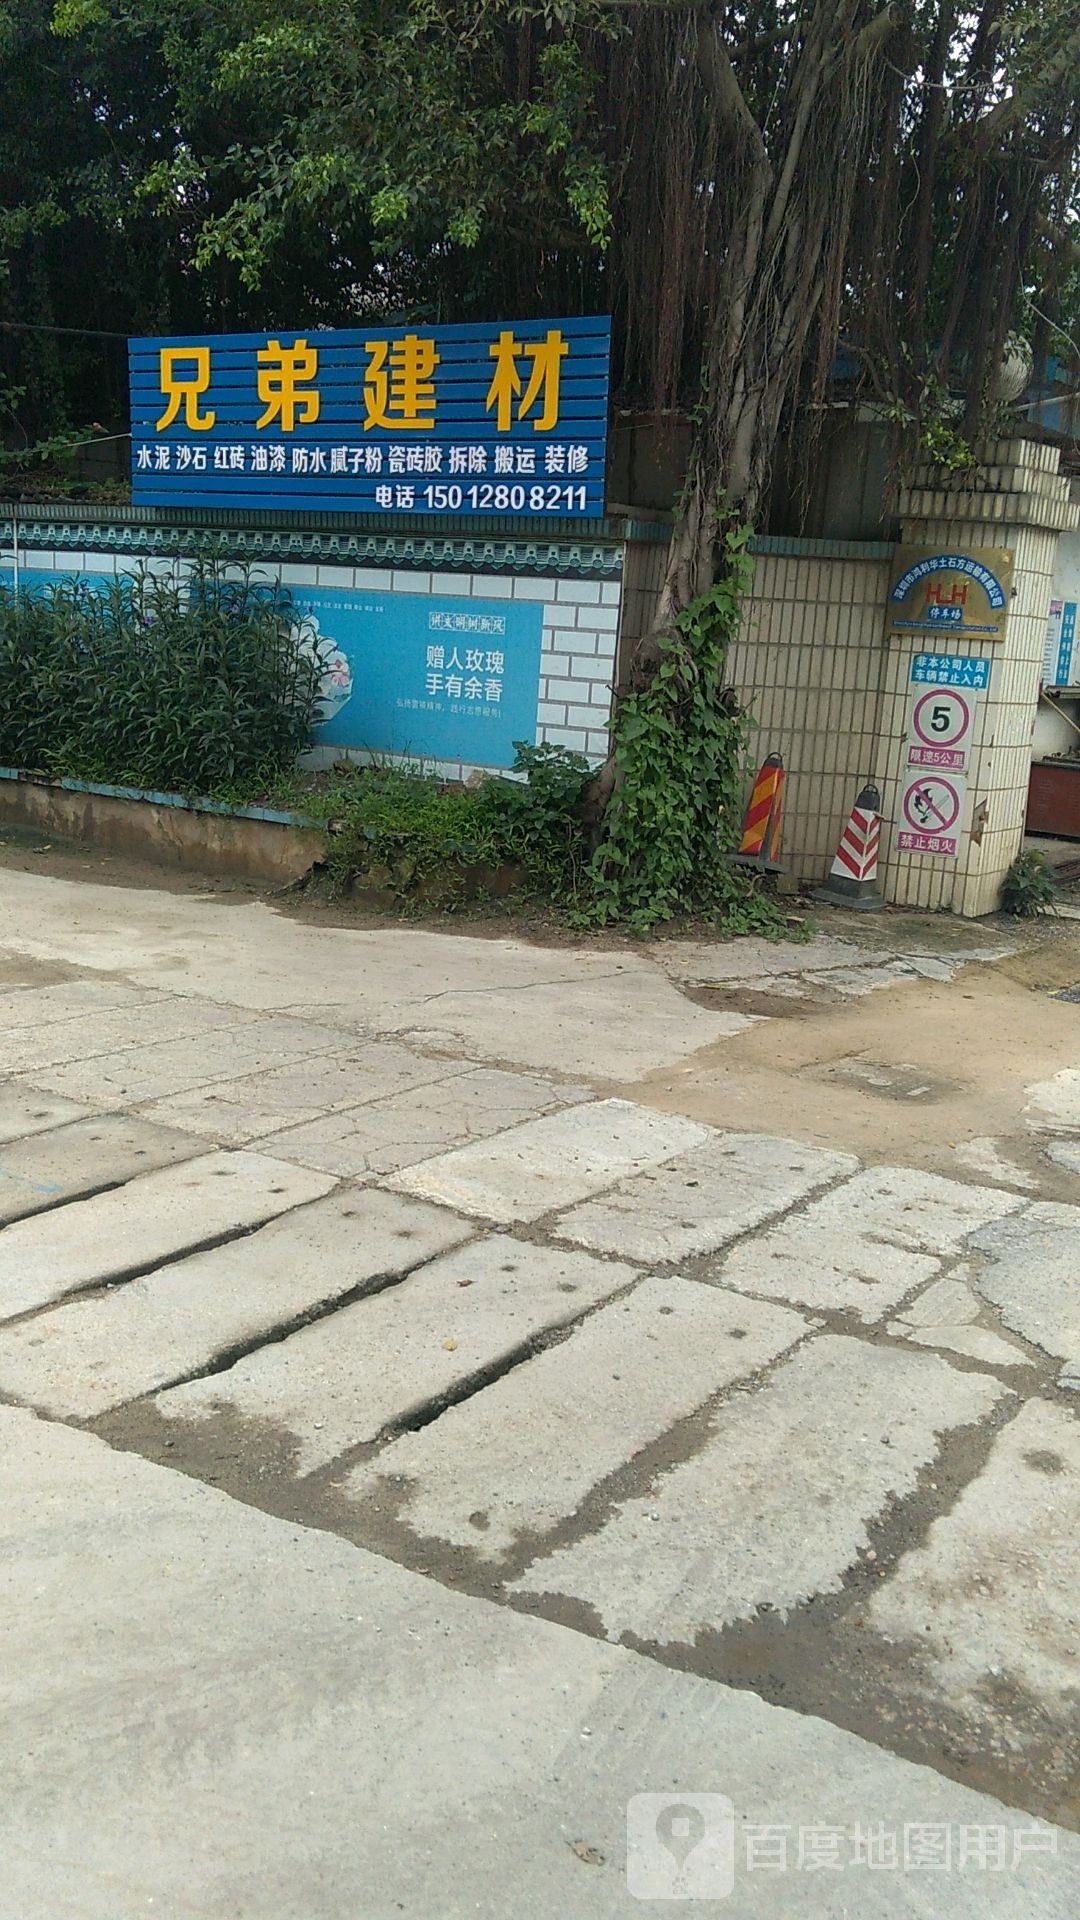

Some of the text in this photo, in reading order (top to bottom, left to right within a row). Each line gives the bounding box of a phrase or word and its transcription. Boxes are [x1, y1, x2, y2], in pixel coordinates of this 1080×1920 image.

[156, 330, 569, 432] 兄弟建材
[137, 444, 589, 474] 水泥 沙石 红砖 油漆 防水 腻子粉 瓷砖胶 拆除 搬运 装修
[375, 484, 416, 509] 电话
[929, 607, 961, 620] 停车场
[425, 645, 505, 674] 赠人玫瑰
[916, 655, 985, 673] 非本公司人员
[425, 673, 504, 702] 手有余香
[915, 669, 984, 687] 车辆禁止入内
[930, 705, 951, 733] 5
[910, 749, 964, 766] 限速5公里
[900, 834, 953, 853] 禁止烟火
